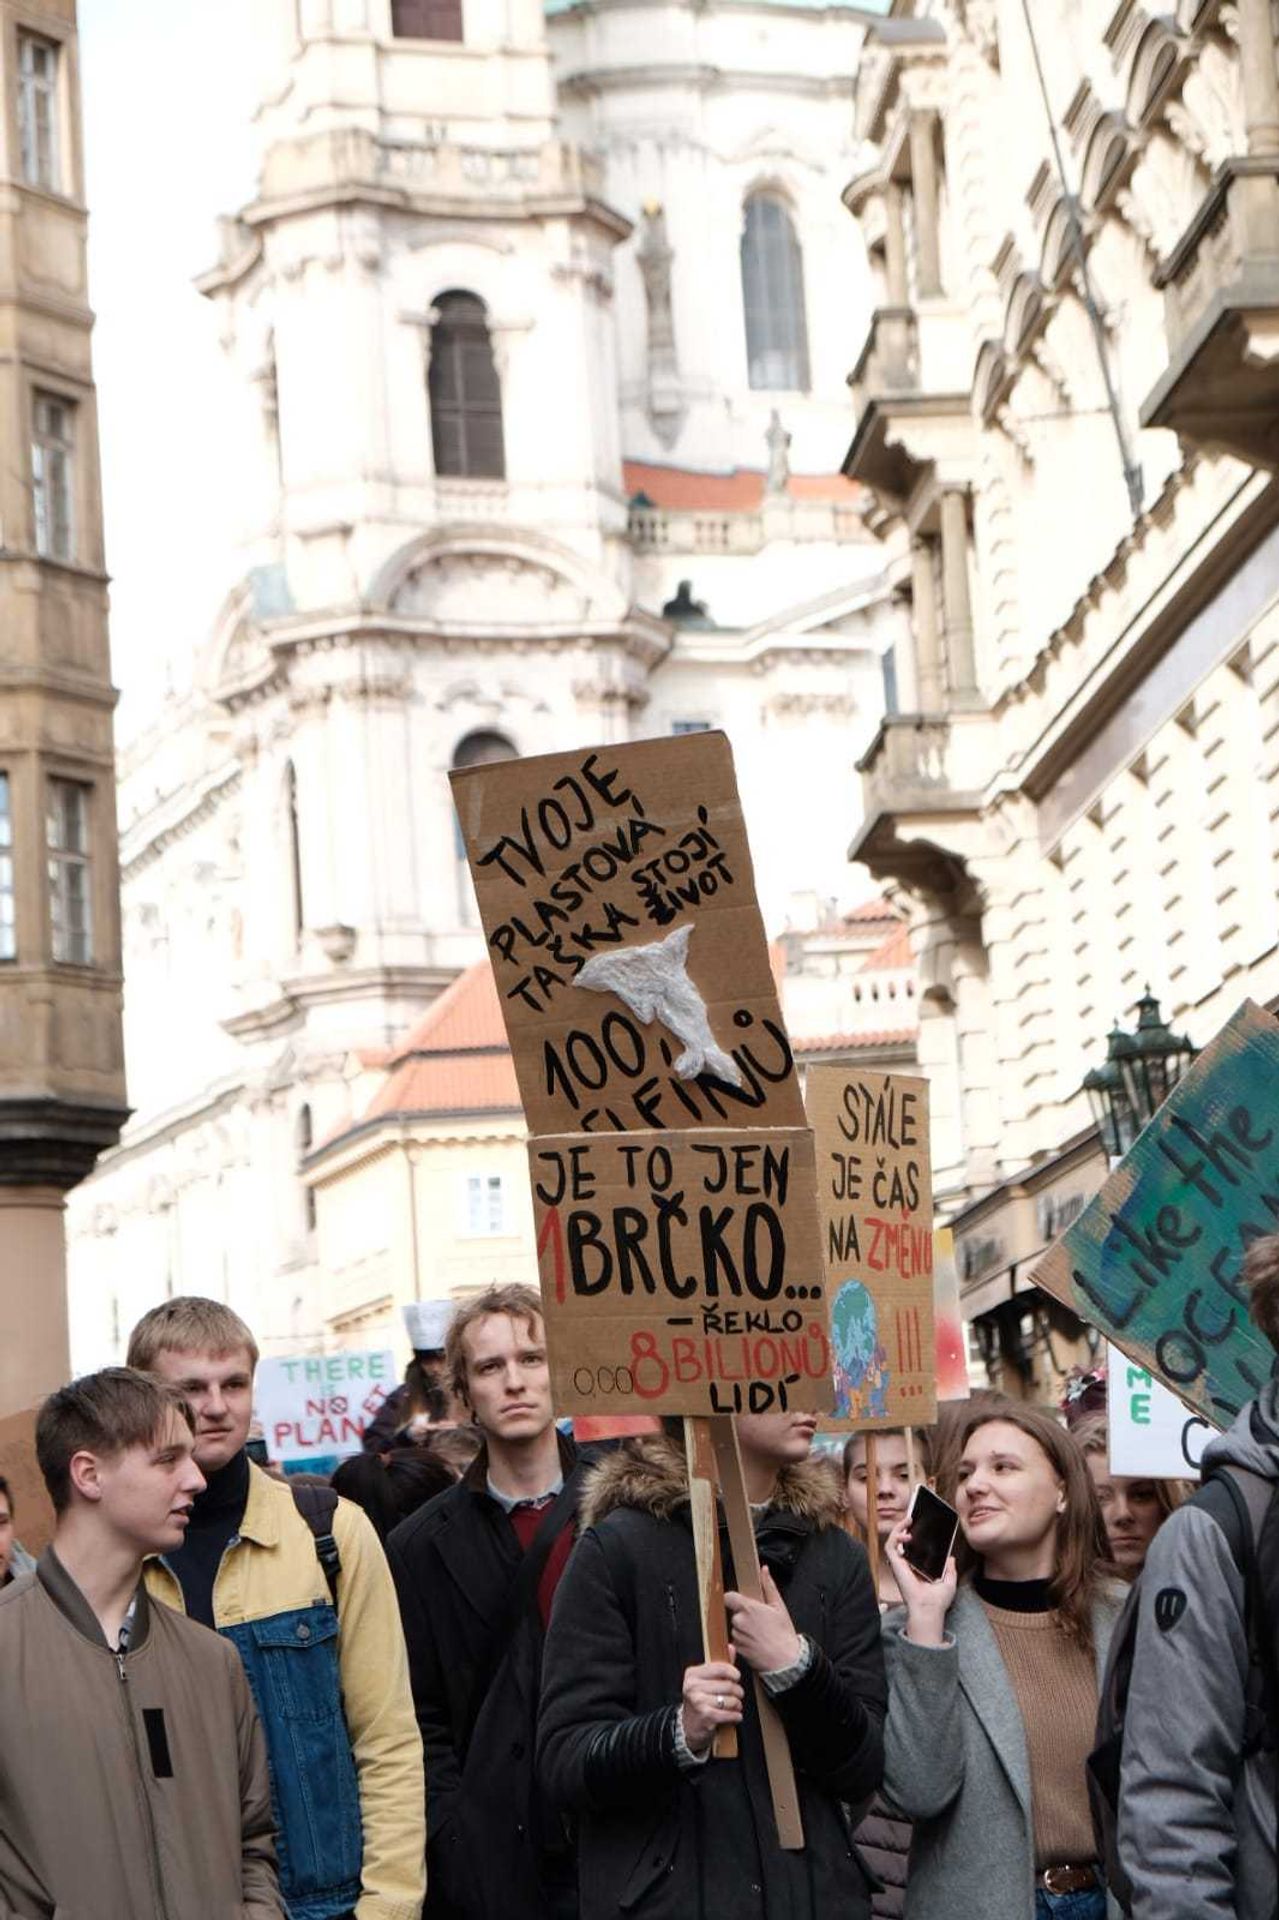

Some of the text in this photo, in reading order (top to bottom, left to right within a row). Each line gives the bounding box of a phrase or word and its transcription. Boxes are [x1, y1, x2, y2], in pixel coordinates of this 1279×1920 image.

[477, 754, 631, 887] TVOJE
[632, 804, 719, 886] STOJÍ
[490, 795, 665, 965] PLASTOVÁ
[508, 902, 638, 1012] TAŠKA
[544, 1010, 645, 1109] 100
[837, 1075, 917, 1150] STÁLE
[536, 1144, 789, 1206] JE TO JEN
[831, 1152, 919, 1212] JE ČAS
[568, 1190, 822, 1300] BRČKO...
[829, 1214, 860, 1263] NA
[864, 1207, 933, 1279] ZMĚNU
[1073, 1104, 1273, 1330] Like the
[671, 1321, 830, 1383] BILIONŮ
[701, 1302, 802, 1335] ŘEKLO
[280, 1354, 386, 1383] THERE
[709, 1374, 800, 1414] LIDÍ
[306, 1396, 348, 1417] NO
